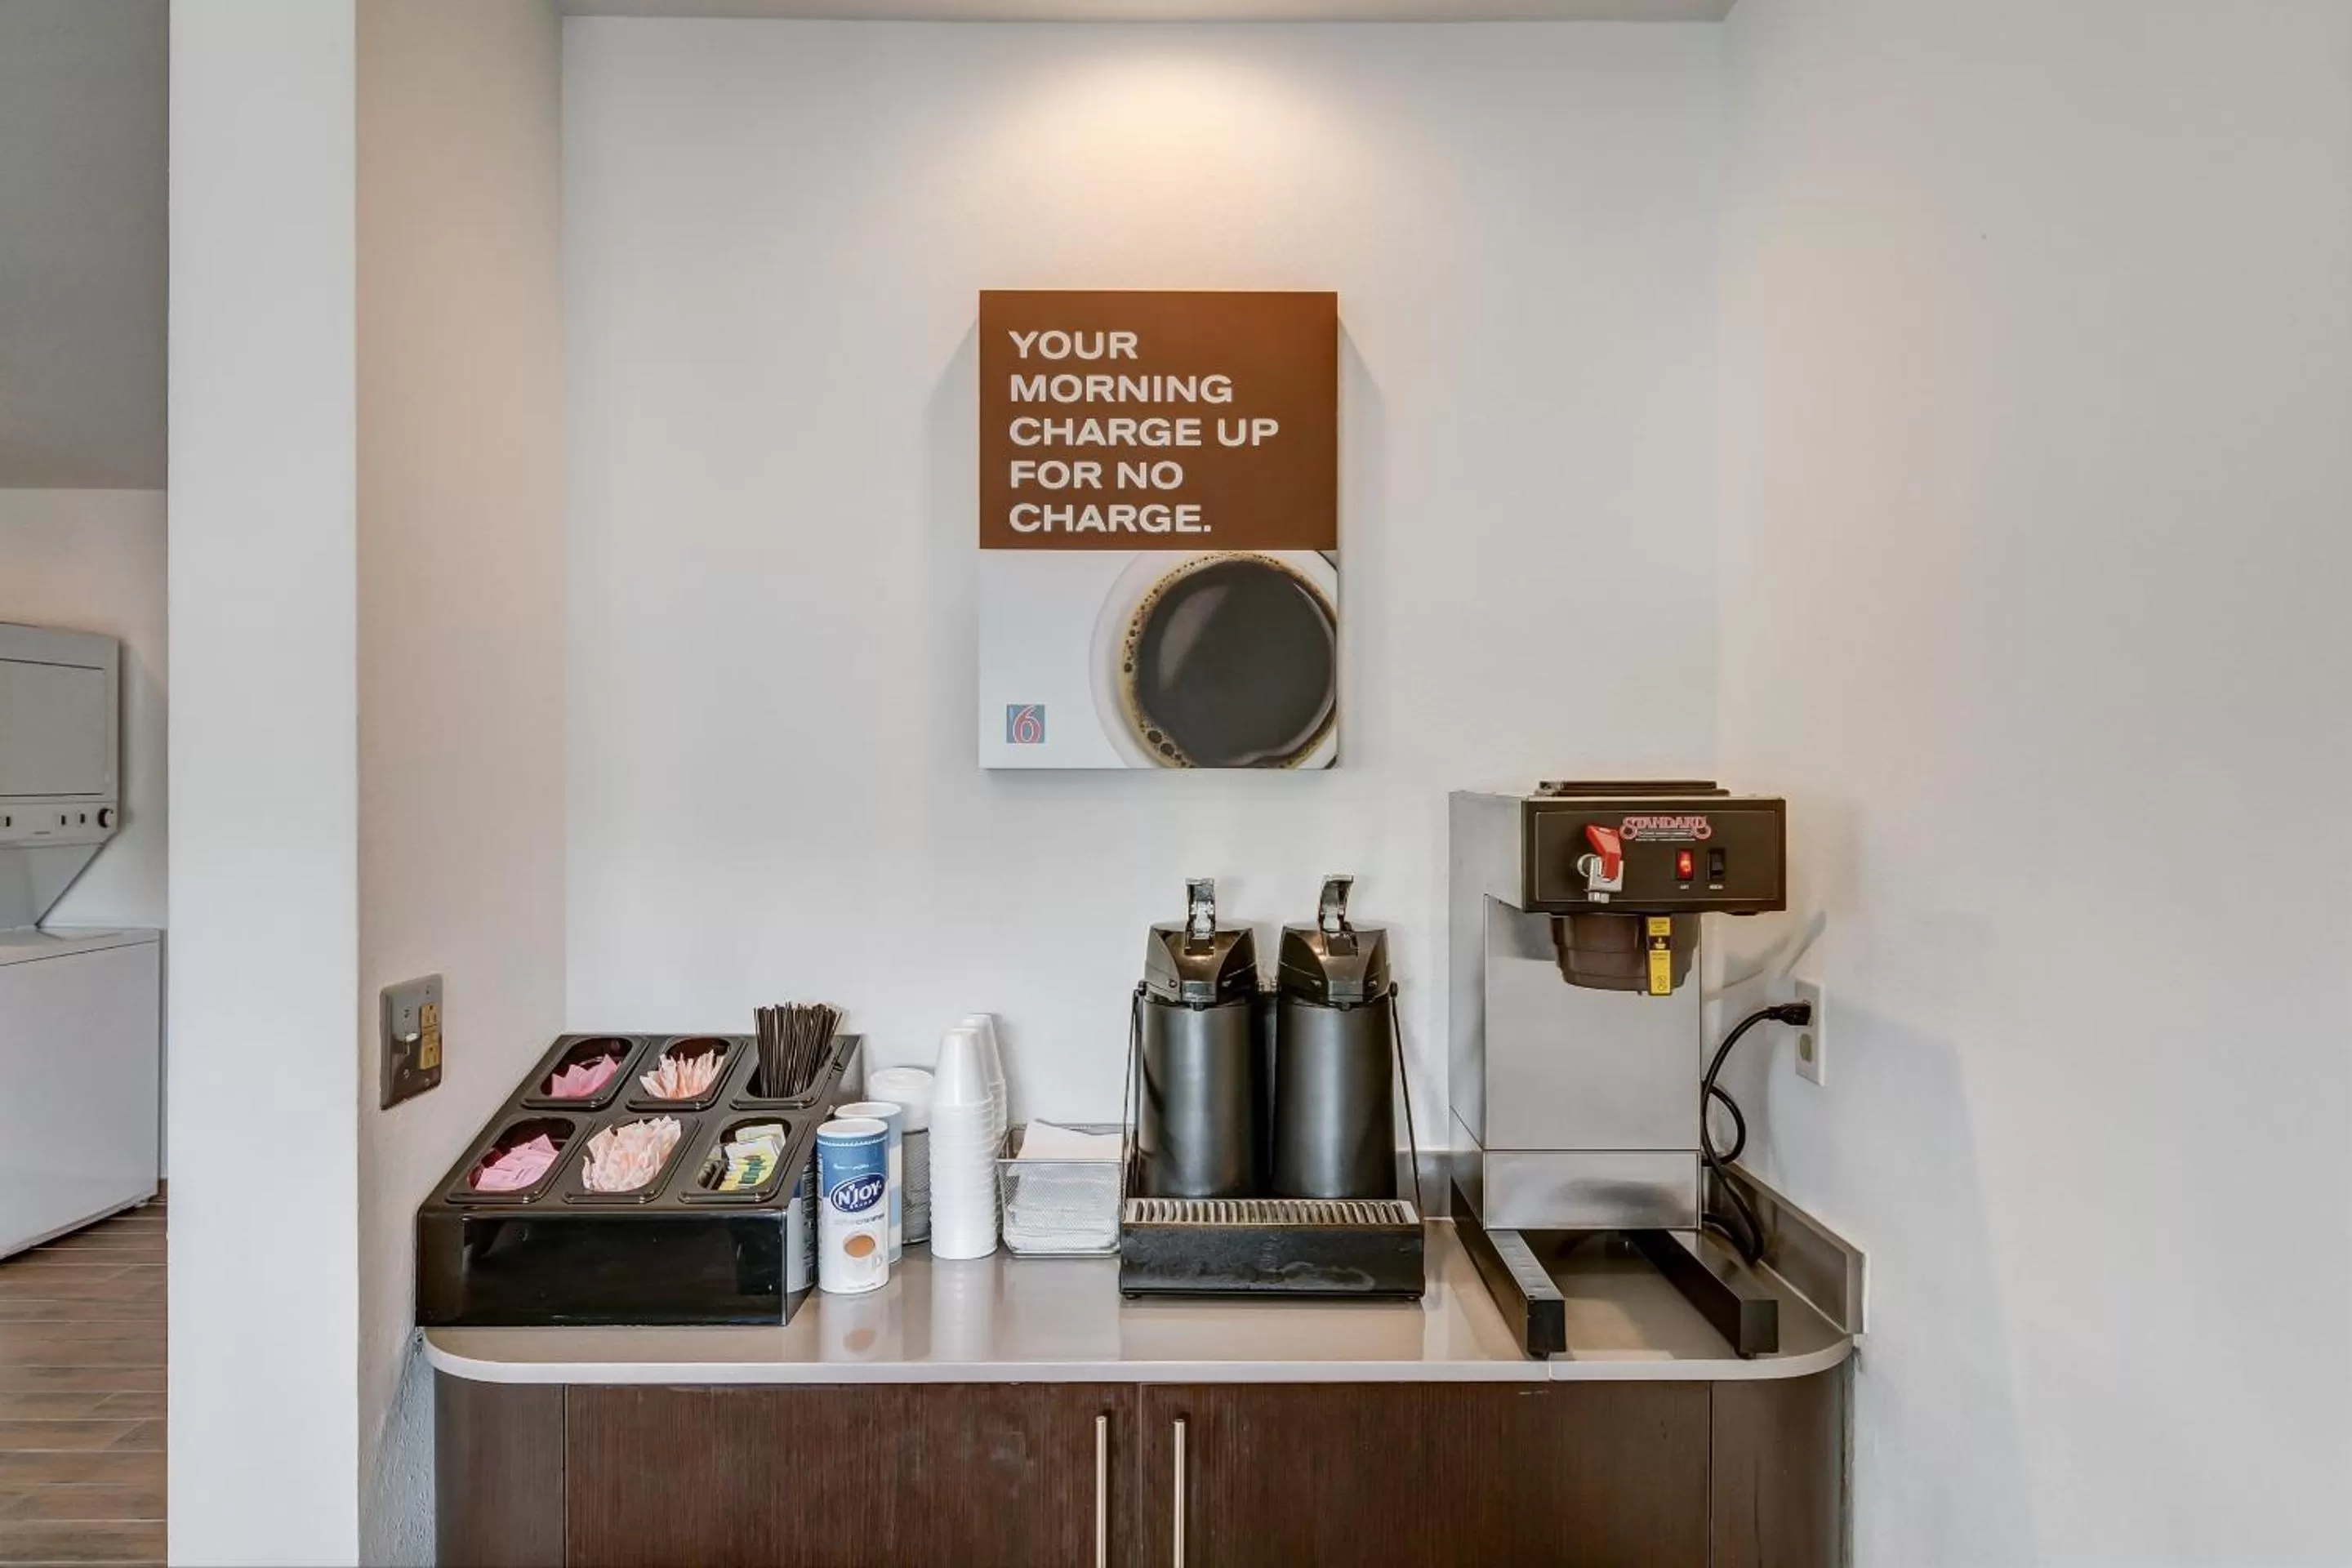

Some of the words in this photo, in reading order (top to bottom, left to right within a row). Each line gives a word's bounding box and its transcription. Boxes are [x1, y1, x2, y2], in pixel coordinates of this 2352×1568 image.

[1009, 330, 1138, 360] YOUR
[1010, 374, 1233, 403] MORNING
[1009, 416, 1202, 447] CHARGE
[1217, 418, 1280, 447] UP
[1010, 460, 1102, 489] FOR
[1117, 461, 1184, 490] NO
[1009, 502, 1212, 532] CHARGE.
[1013, 705, 1041, 744] 6
[1619, 816, 1711, 840] STANDARD
